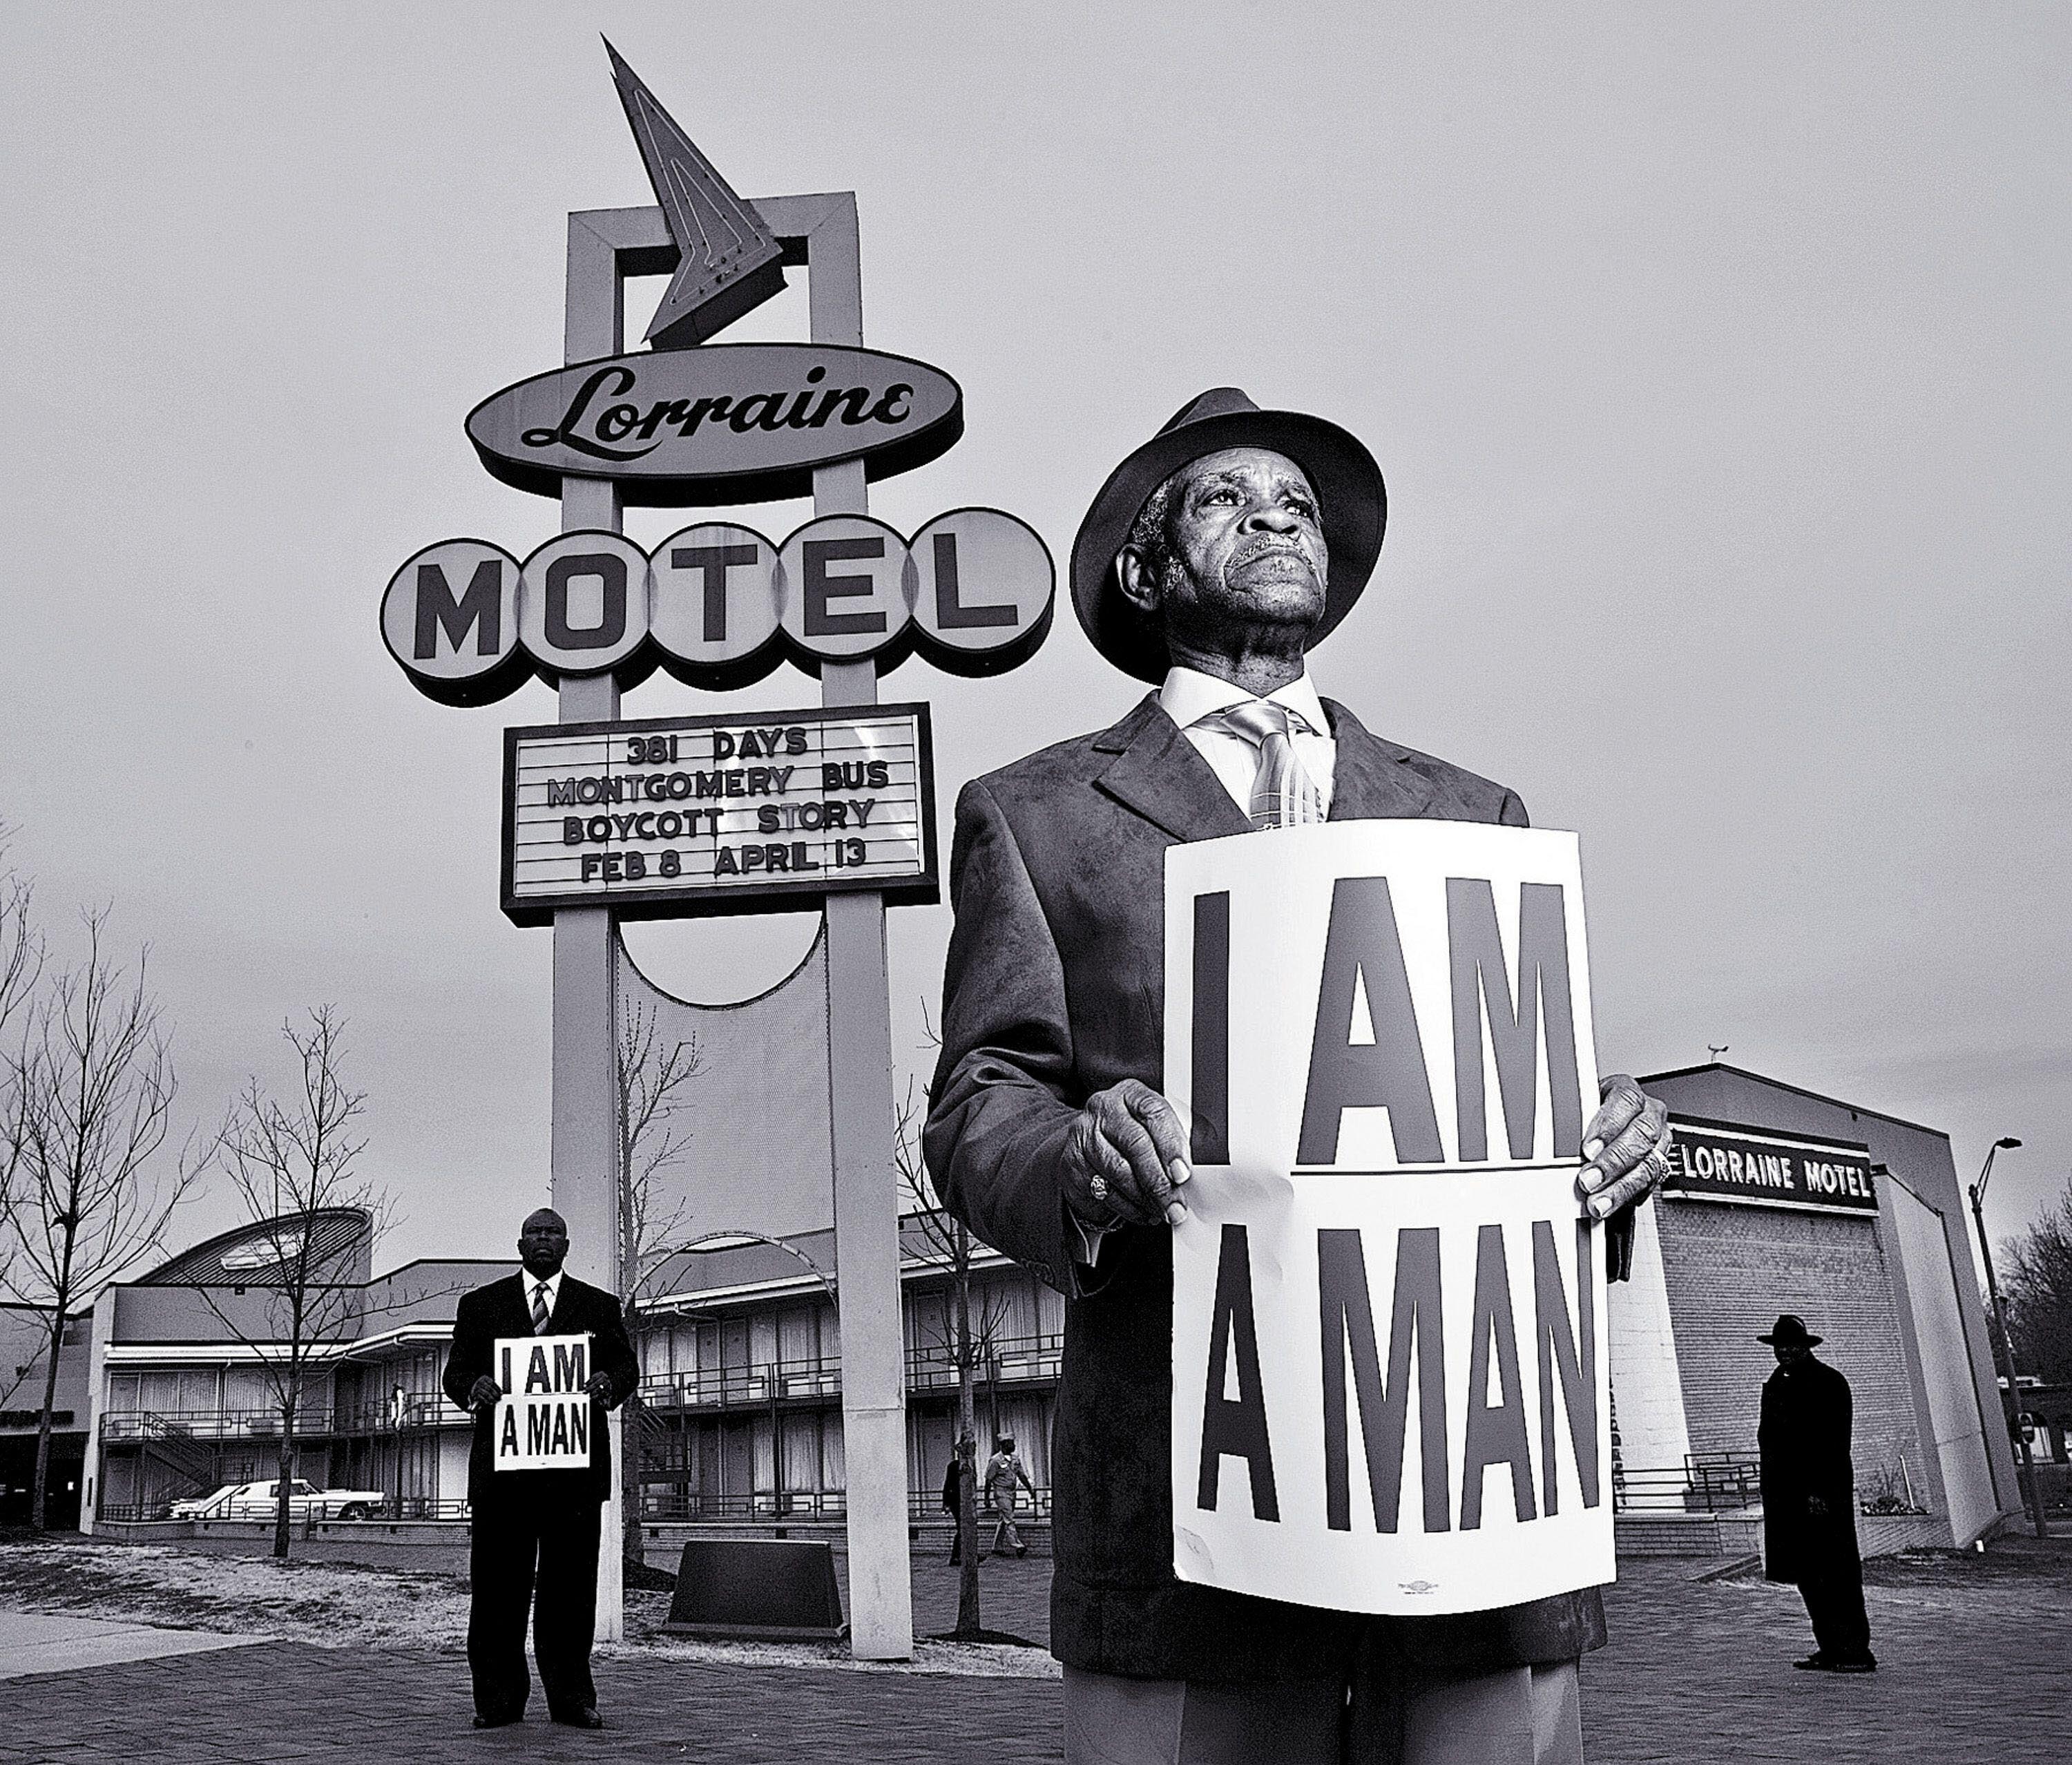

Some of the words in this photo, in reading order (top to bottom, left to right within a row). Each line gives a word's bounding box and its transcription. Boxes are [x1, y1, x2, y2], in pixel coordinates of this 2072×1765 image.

[521, 365, 914, 462] Lorraine
[414, 533, 1019, 660] MOTEL
[627, 734, 678, 765] 381
[714, 727, 807, 760] DAYS
[548, 765, 794, 808] MONTGOMERY
[822, 761, 889, 790] BUS
[564, 808, 724, 845] BOYCOTT
[758, 799, 875, 833] STORY
[582, 851, 646, 882] FEB
[659, 849, 681, 878] 8
[715, 841, 819, 875] APRIL
[835, 837, 866, 868] 13
[1190, 890, 1230, 1165] I
[1296, 876, 1582, 1165] AM
[1681, 1144, 1794, 1190] LORRAINE
[1803, 1160, 1871, 1197] MOTEL
[501, 1347, 512, 1394] I
[525, 1344, 586, 1393] AM
[1197, 1223, 1280, 1523] A
[1317, 1217, 1600, 1533] MAN
[500, 1404, 519, 1457] A
[527, 1402, 588, 1456] MAN
